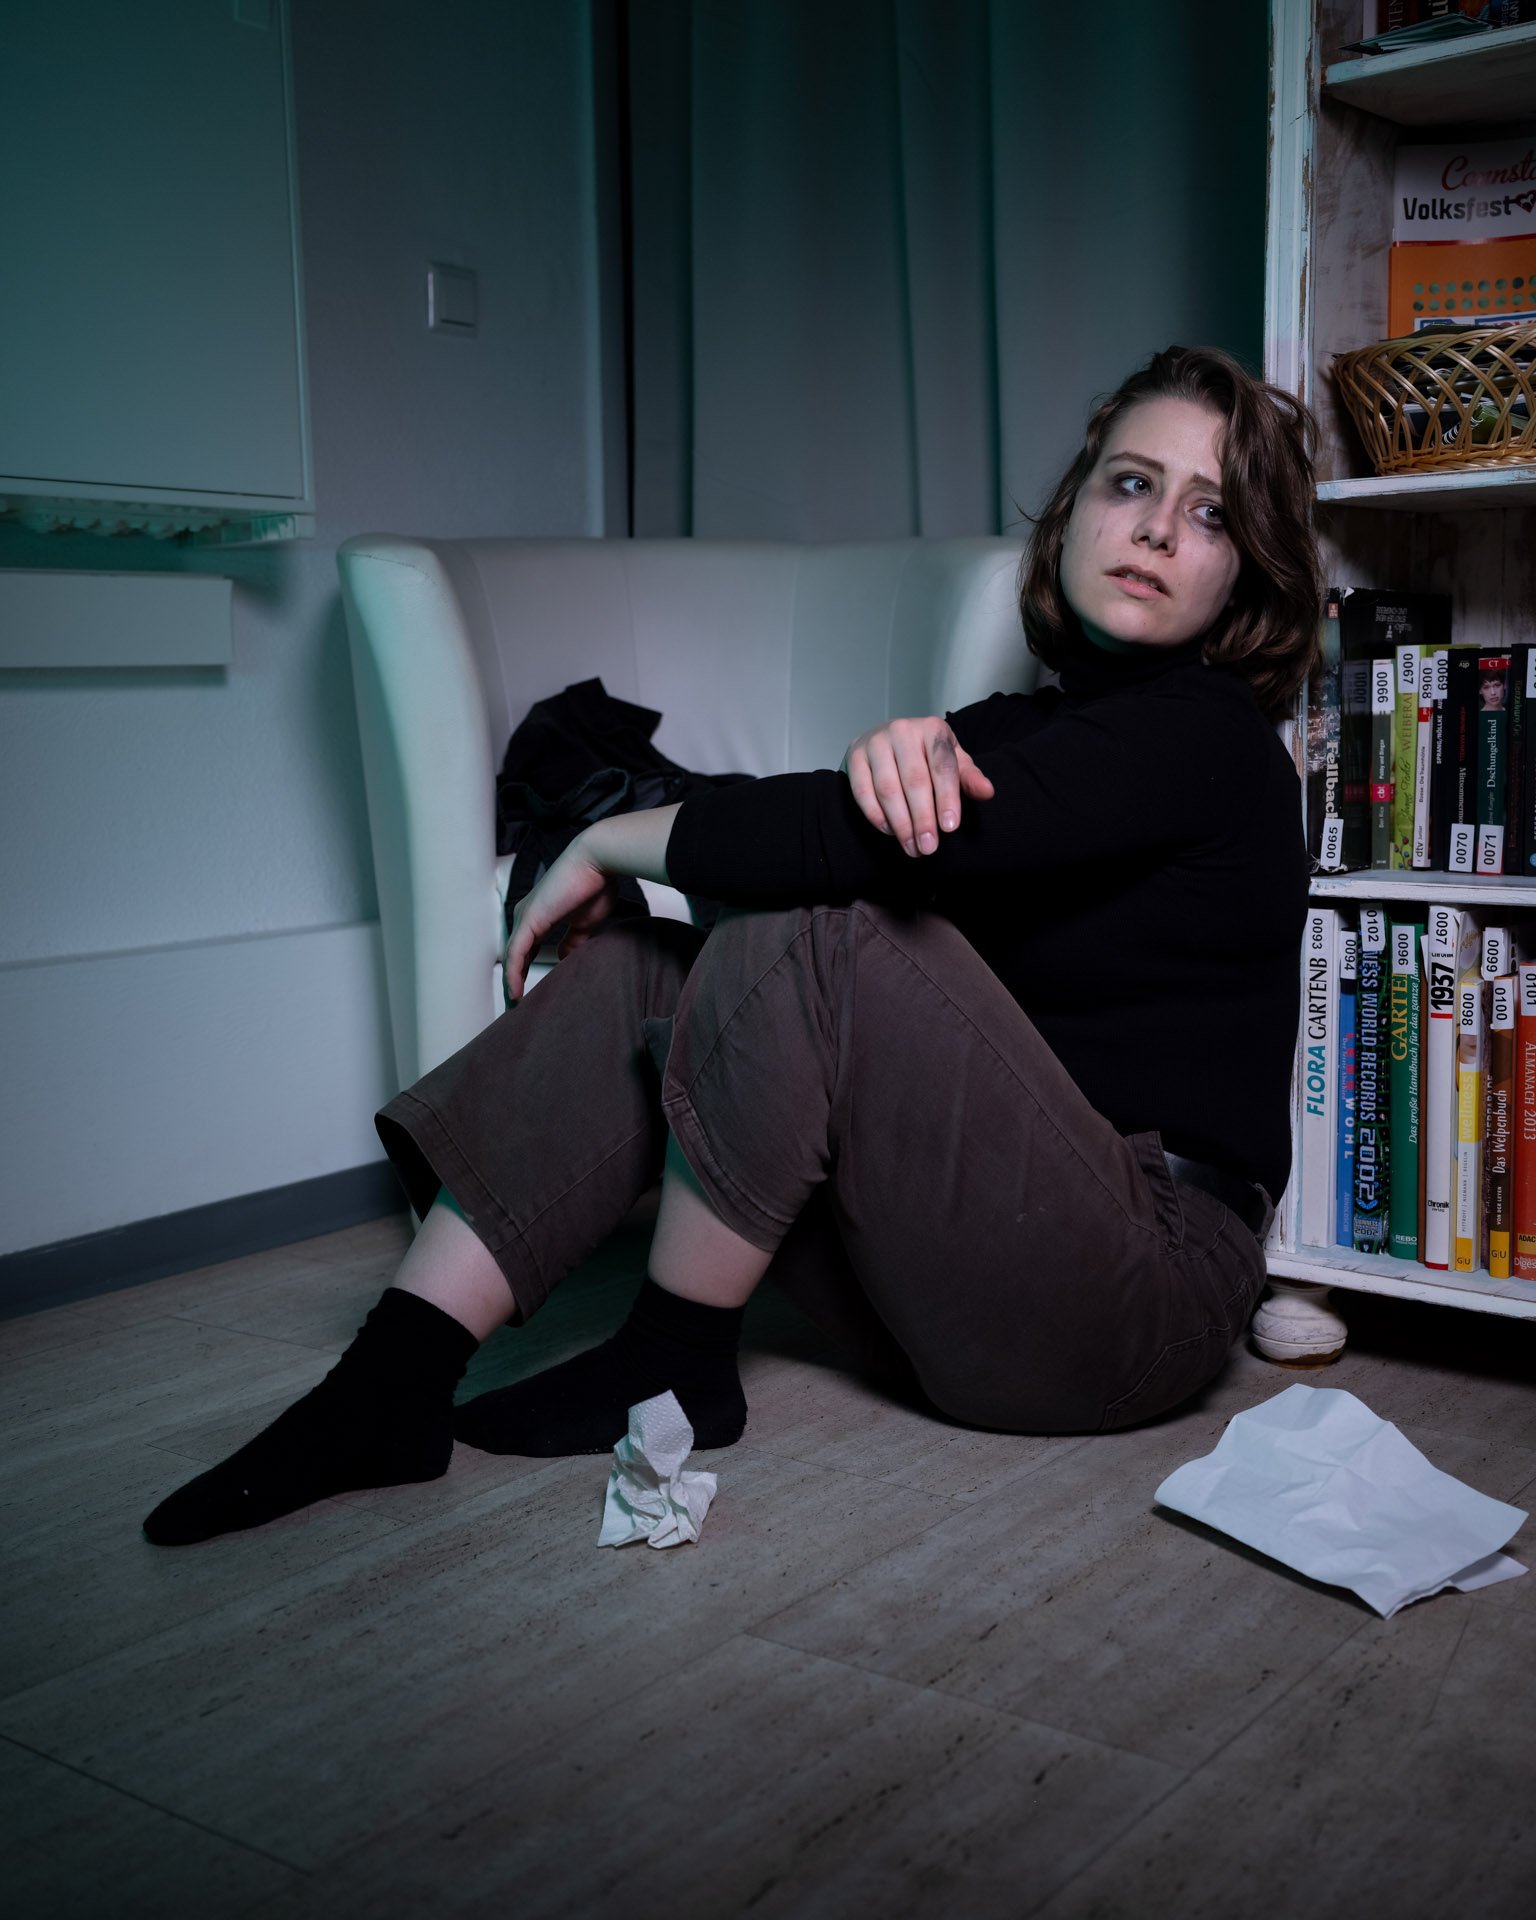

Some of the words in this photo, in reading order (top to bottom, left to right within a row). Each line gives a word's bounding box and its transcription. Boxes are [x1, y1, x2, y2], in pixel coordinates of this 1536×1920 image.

[1402, 195, 1512, 223] Volksfest
[1402, 652, 1414, 685] 0067
[1422, 667, 1433, 699] 0068
[1437, 658, 1448, 691] 0069
[1376, 671, 1389, 703] 0066
[1401, 692, 1412, 752] WEIBERA
[1486, 719, 1498, 788] Dschungelkind
[1376, 785, 1386, 799] cbt
[1458, 767, 1466, 824] Mittsommermo
[1326, 826, 1338, 859] 0065
[1415, 842, 1424, 857] dtv
[1455, 832, 1468, 864] 0070
[1483, 834, 1497, 866] 0071
[1312, 918, 1323, 950] 0093
[1366, 910, 1379, 942] 0102
[1435, 912, 1449, 945] 0097
[1344, 939, 1357, 971] 0094
[1397, 933, 1409, 966] 0096
[1486, 939, 1499, 973] 0099
[1308, 957, 1328, 1040] GARTENB
[1410, 982, 1420, 1011] ganze
[1430, 962, 1454, 1011] 1937
[1525, 973, 1536, 1006] 0101
[1361, 992, 1378, 1048] WORLD
[1391, 973, 1408, 1061] GARTE
[1409, 1012, 1418, 1029] das
[1461, 993, 1475, 1026] 0098
[1494, 987, 1508, 1021] 0100
[1409, 1030, 1420, 1046] für
[1306, 1045, 1326, 1116] FLORA
[1360, 1051, 1377, 1121] RECORDS
[1408, 1046, 1419, 1096] Handbuch
[1524, 1041, 1536, 1105] ALMANACH
[1409, 1097, 1419, 1125] große
[1460, 1075, 1473, 1139] wellness
[1492, 1089, 1510, 1153] Welpenbuch
[1408, 1126, 1418, 1144] Das
[1523, 1110, 1536, 1140] 2013
[1359, 1127, 1376, 1201] 2002
[1491, 1156, 1507, 1174] Das
[1427, 1199, 1449, 1209] Chronik
[1395, 1234, 1418, 1242] REBO
[1518, 1234, 1536, 1243] ADAC
